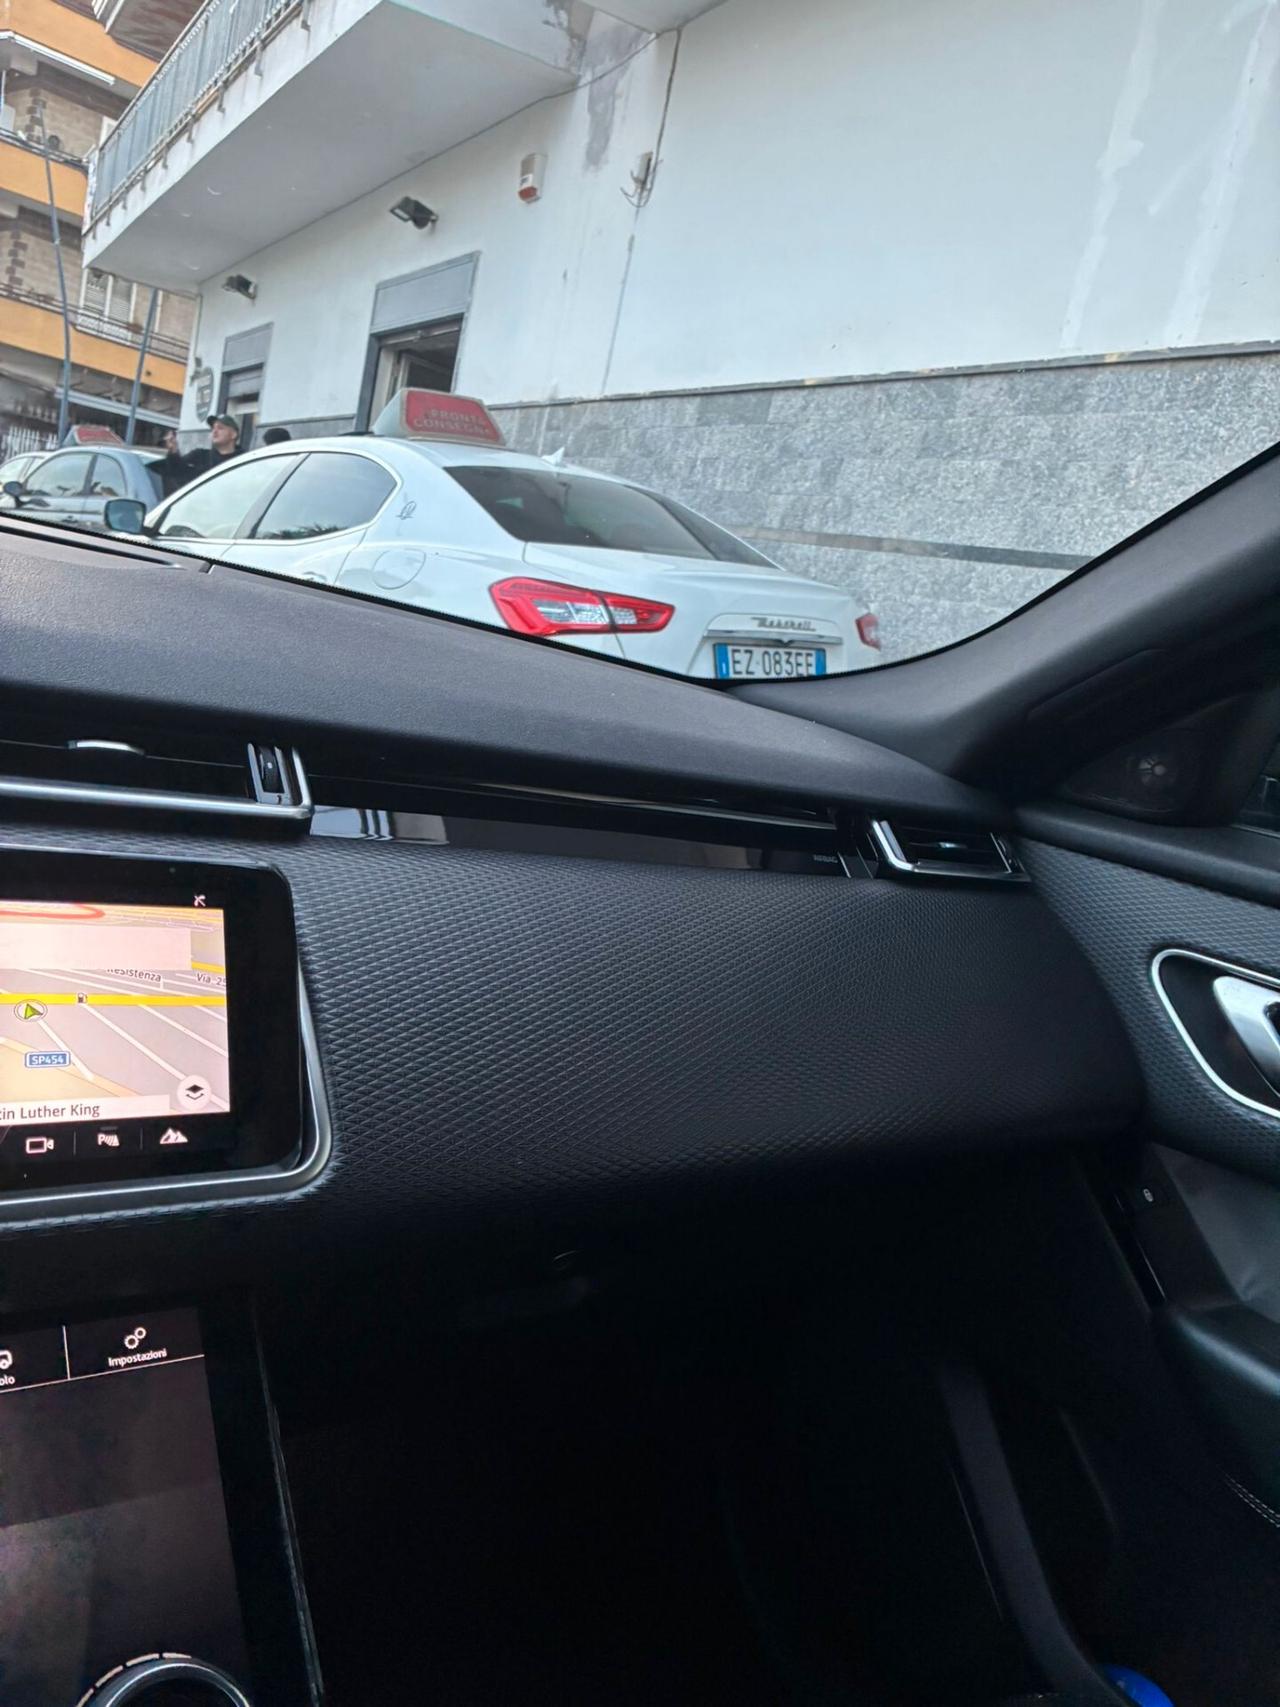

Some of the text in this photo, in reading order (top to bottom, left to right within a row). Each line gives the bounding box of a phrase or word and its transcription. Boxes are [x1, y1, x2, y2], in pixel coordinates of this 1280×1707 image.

[731, 649, 755, 675] EZ
[196, 972, 211, 984] Via
[31, 1055, 65, 1065] SP454
[20, 1105, 66, 1119] Luther
[70, 1103, 100, 1118] King
[108, 1348, 168, 1368] Impostazioni
